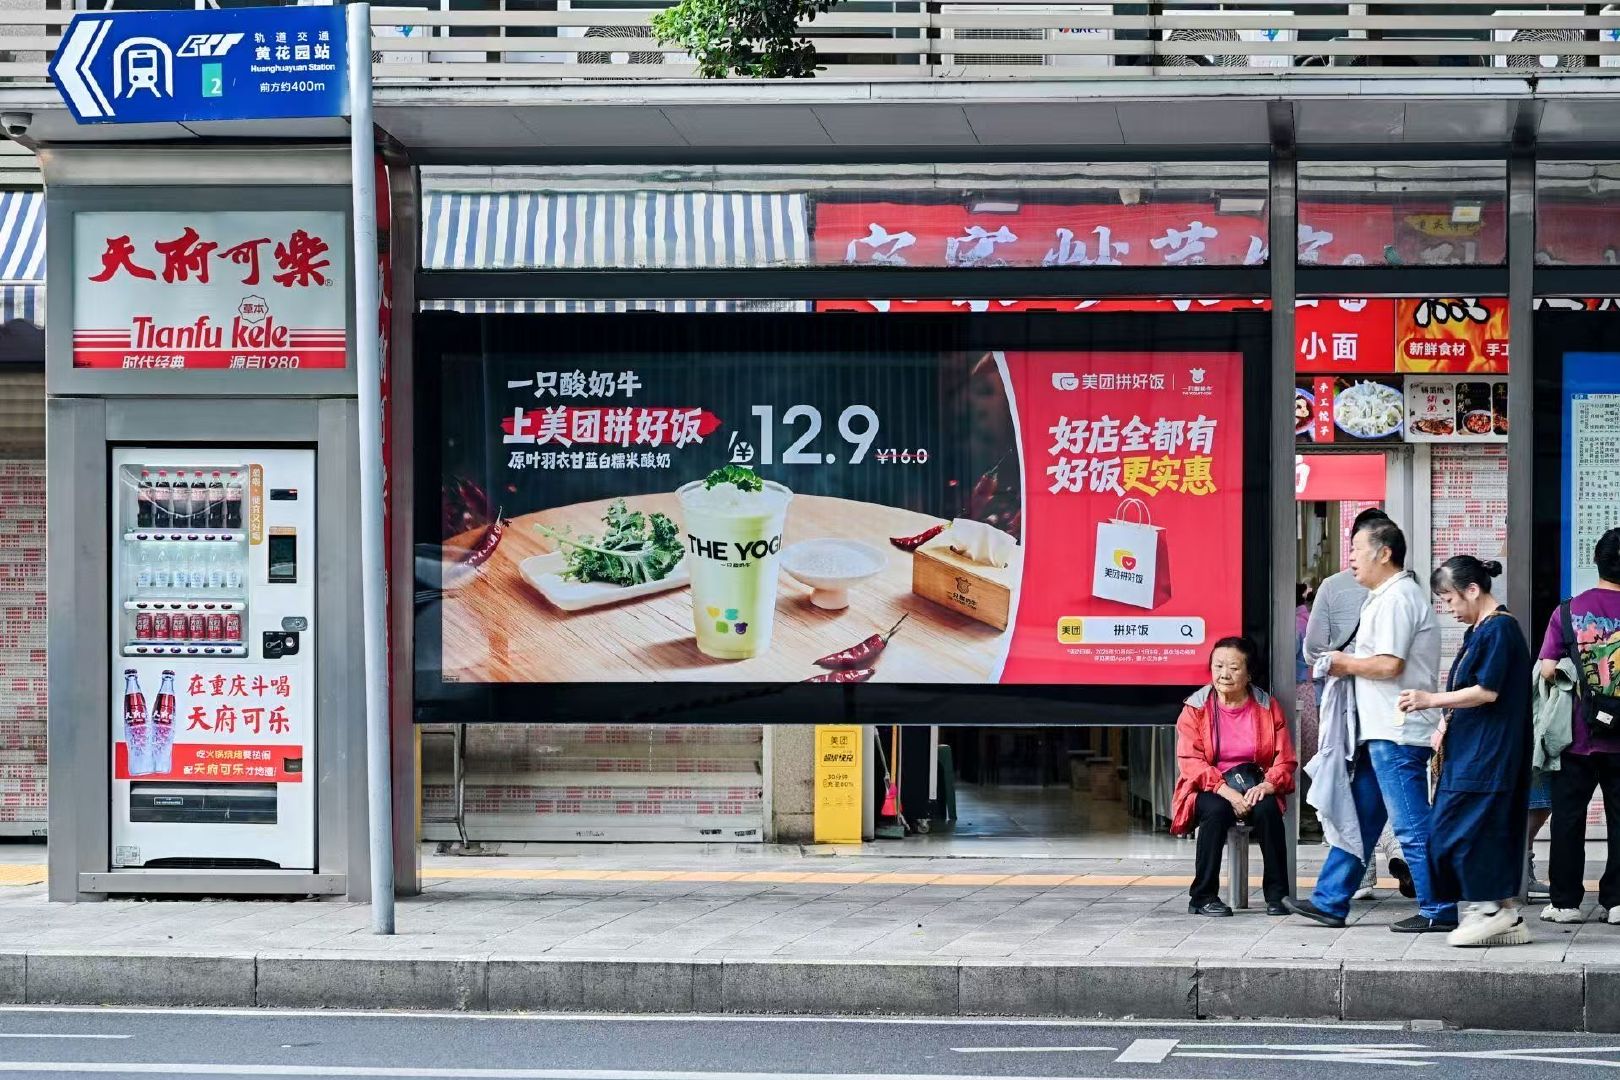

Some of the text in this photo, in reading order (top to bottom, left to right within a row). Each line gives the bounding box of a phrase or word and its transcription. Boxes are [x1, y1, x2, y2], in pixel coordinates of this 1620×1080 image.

[254, 30, 330, 44] 轨道交通
[255, 44, 331, 61] 黄花园站
[250, 63, 336, 74] Huanghuayuan Station
[210, 77, 222, 95] 2
[259, 80, 326, 93] 前方约400m
[243, 303, 265, 314] 草本
[132, 315, 291, 349] Tianfu kele
[1300, 331, 1359, 361] 小面
[1409, 341, 1466, 356] 新鲜食材
[122, 355, 185, 369] 时代经典
[229, 355, 300, 369] 源自1980
[507, 369, 642, 398] 一只酸奶牛
[1081, 373, 1165, 390] 美团拼好饭
[503, 405, 703, 449] 上美团拼好饭
[1048, 415, 1217, 455] 好店全都有
[508, 451, 671, 470] 原叶羽衣甘蓝白糯米酸奶
[877, 448, 928, 464] ¥16.0
[1047, 455, 1217, 497] 好饭更实惠
[688, 533, 782, 561] THE YOG
[1104, 567, 1144, 584] 美团拼好饭
[1061, 625, 1081, 636] 美团
[1113, 624, 1149, 636] 拼好饭
[187, 674, 290, 697] 在重庆斗喝
[186, 704, 290, 735] 天府可乐
